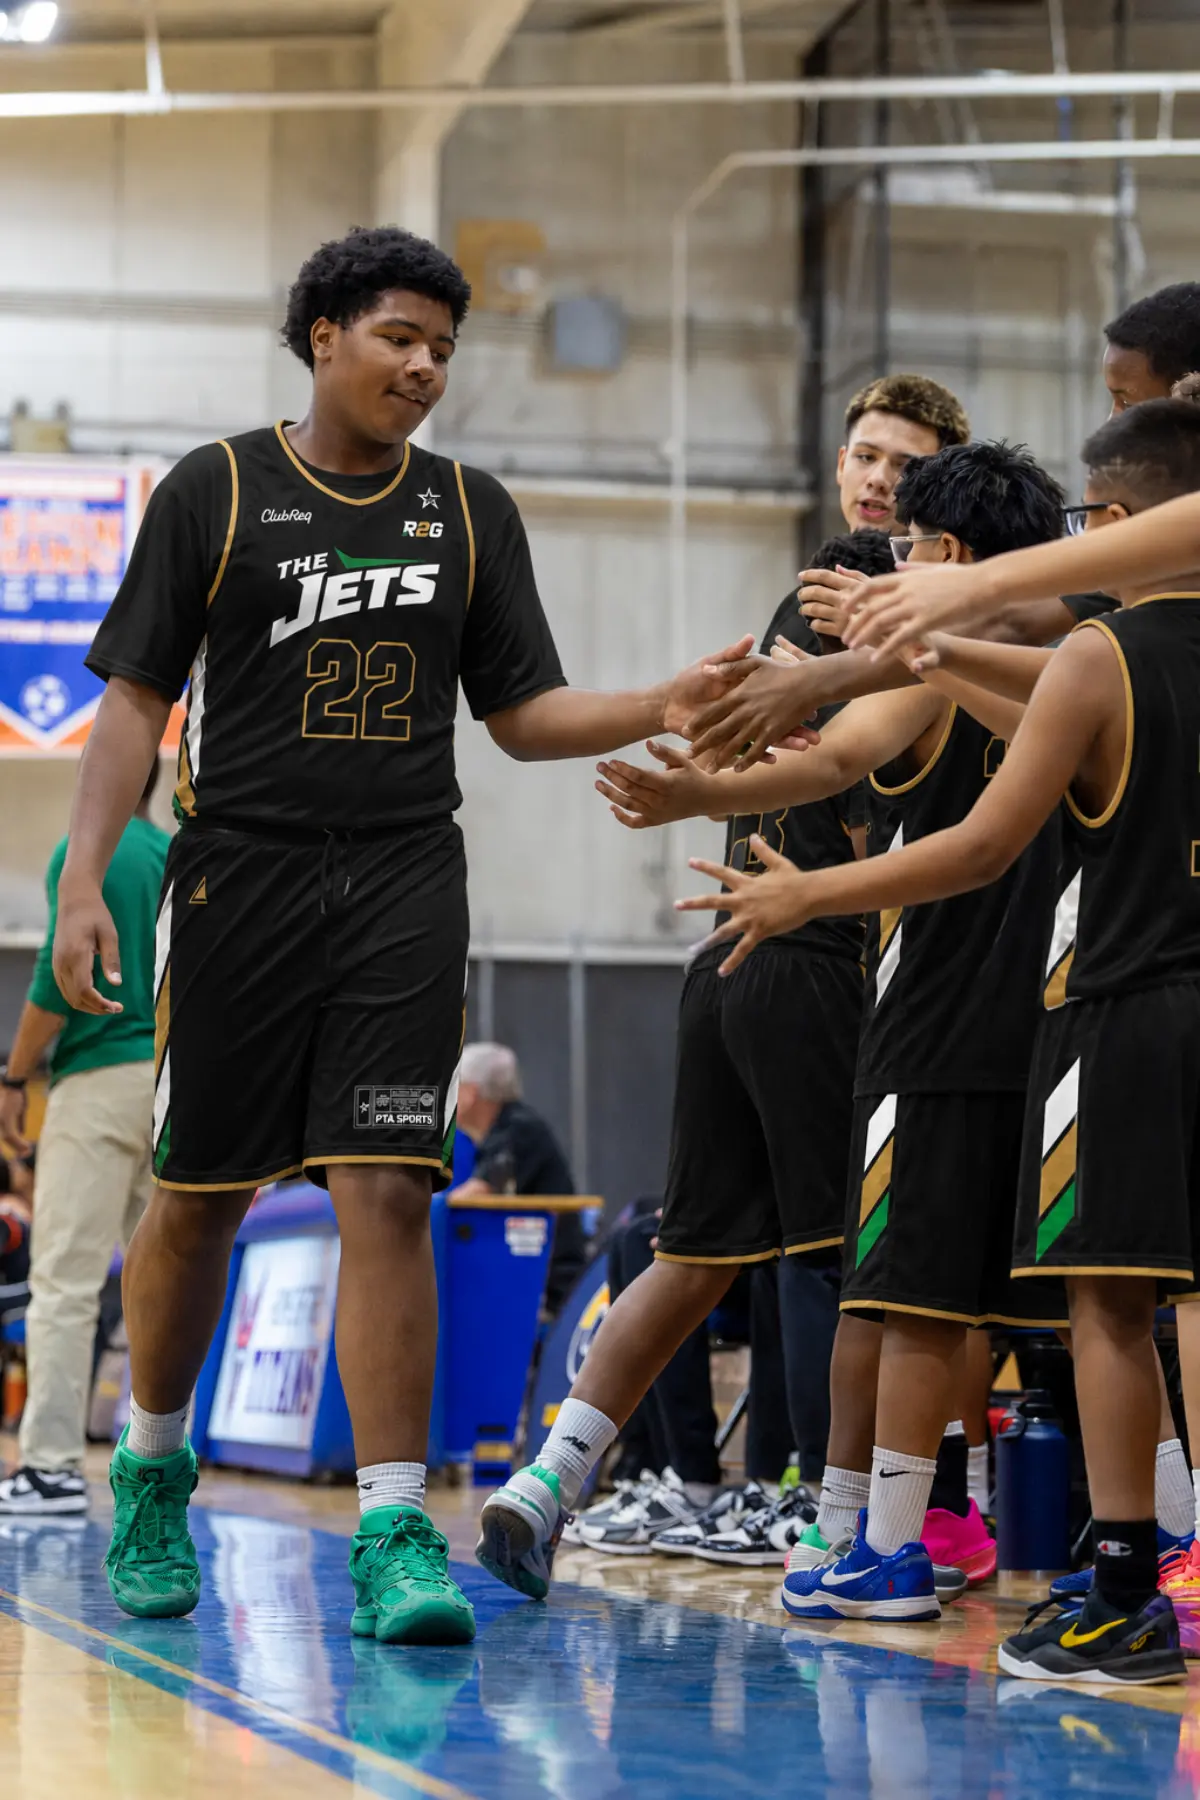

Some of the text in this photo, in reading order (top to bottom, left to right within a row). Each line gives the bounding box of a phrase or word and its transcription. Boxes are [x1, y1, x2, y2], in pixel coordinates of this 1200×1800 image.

[401, 520, 444, 538] R2G
[277, 552, 328, 580] THE
[268, 563, 441, 649] JETS
[301, 638, 417, 741] 22
[375, 1114, 433, 1125] PTA SPORTS
